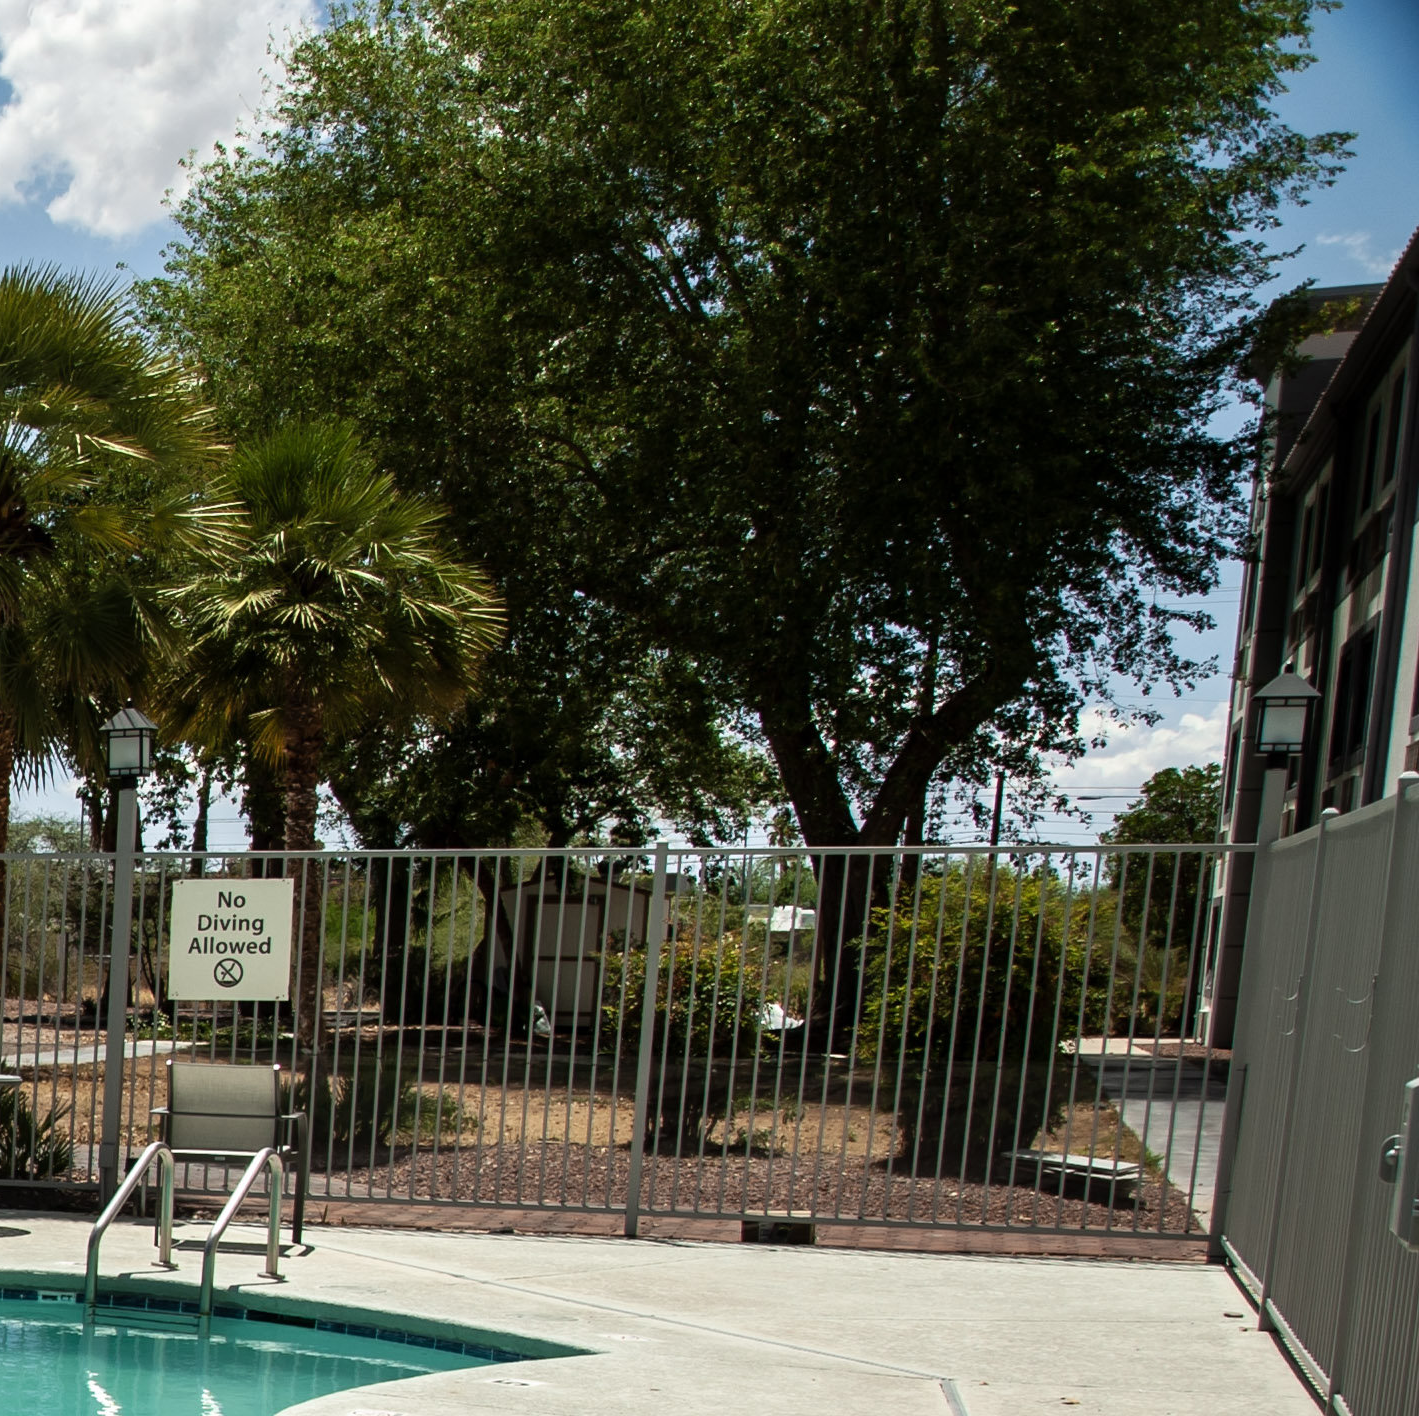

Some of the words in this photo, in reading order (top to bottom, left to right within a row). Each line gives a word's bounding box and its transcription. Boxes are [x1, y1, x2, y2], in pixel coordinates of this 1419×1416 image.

[218, 891, 246, 908] No
[198, 914, 264, 935] Diving
[188, 937, 271, 954] Allowed
